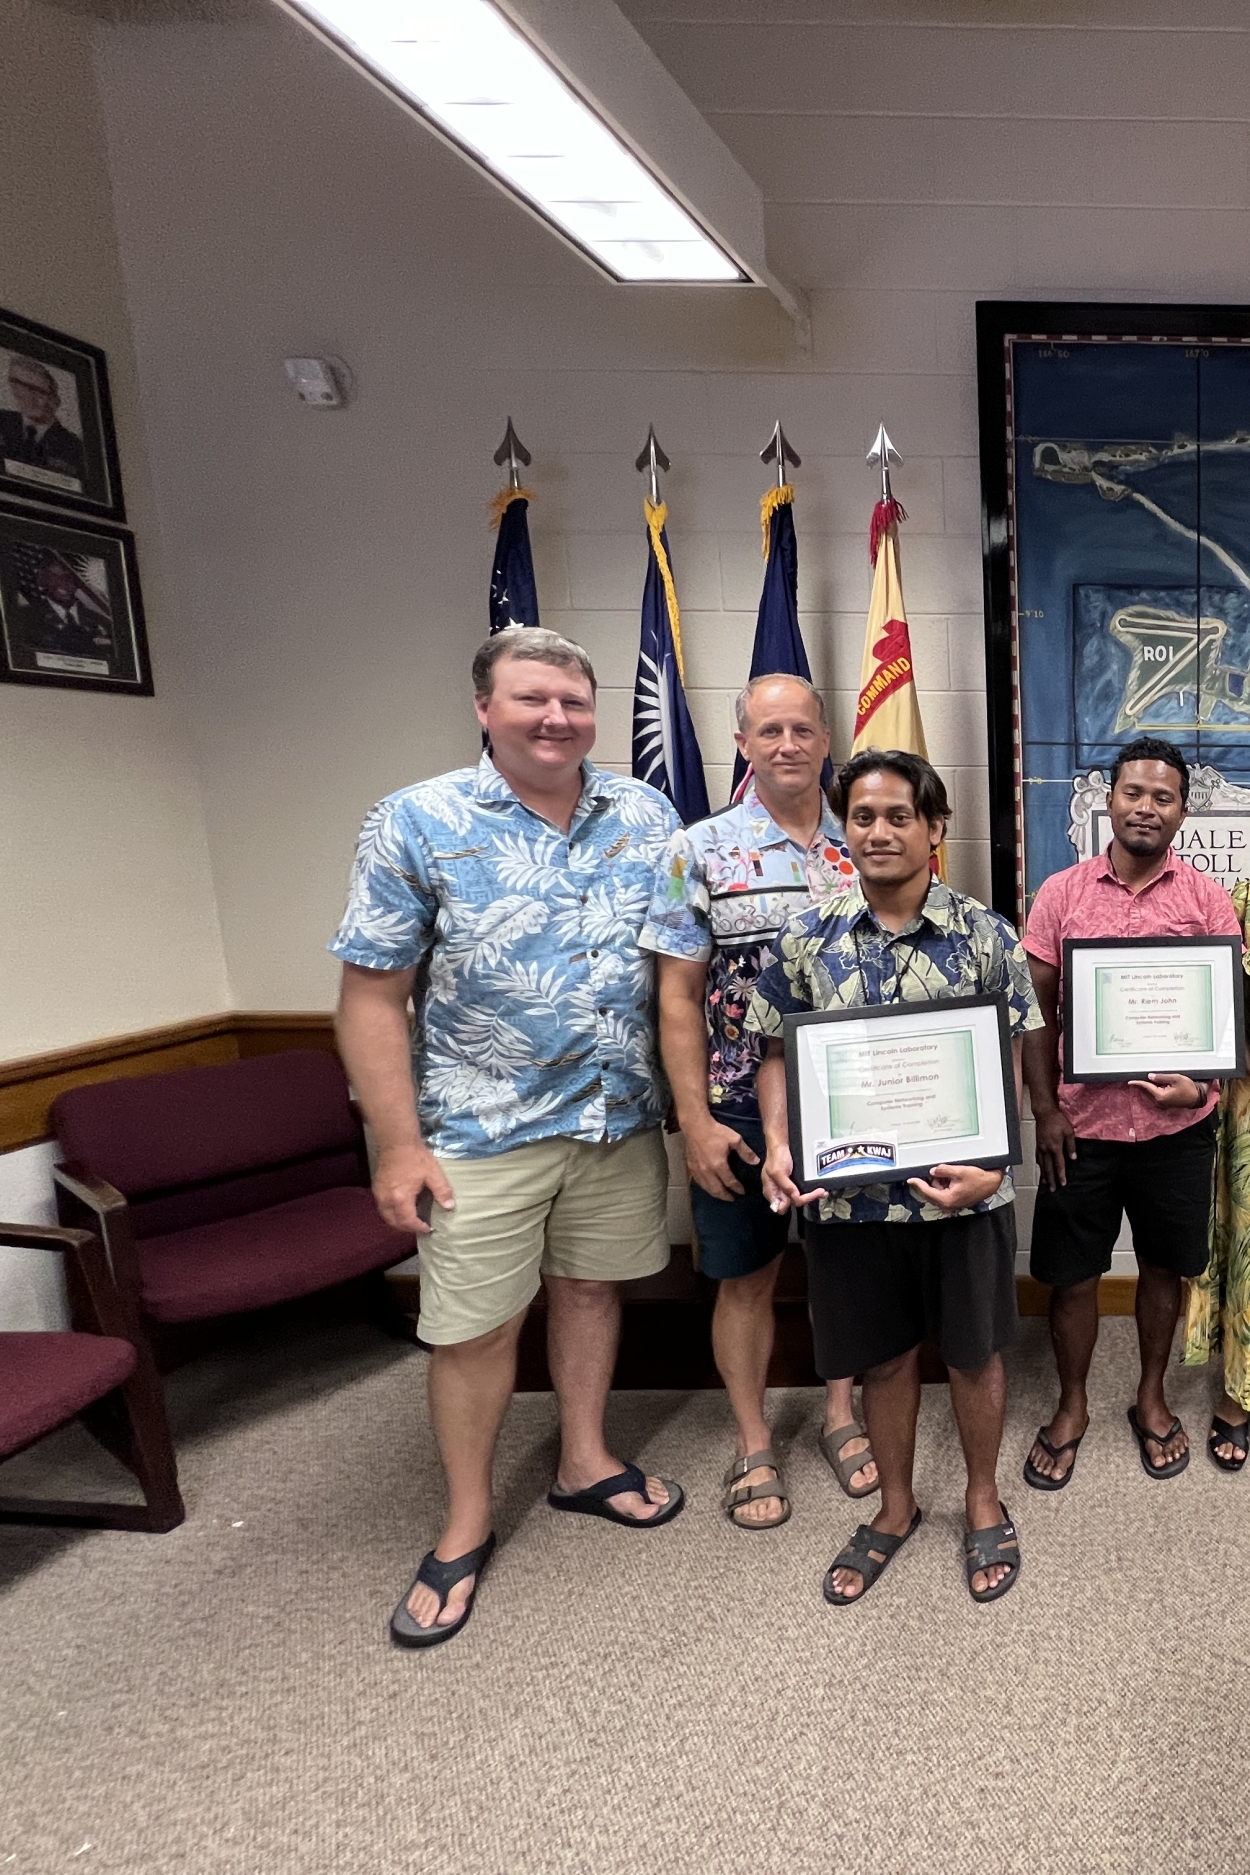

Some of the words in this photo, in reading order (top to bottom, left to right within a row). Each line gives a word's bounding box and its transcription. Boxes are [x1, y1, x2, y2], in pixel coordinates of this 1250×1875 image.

[1143, 646, 1174, 662] ROI
[857, 657, 910, 715] COMMAND
[1176, 853, 1242, 873] TOLL
[900, 1044, 938, 1053] Laboratory
[902, 1059, 939, 1068] Completion
[878, 1078, 903, 1086] Junior
[906, 1073, 939, 1083] Billimon
[821, 1148, 845, 1165] TEAM
[867, 1145, 891, 1158] KWAJ
